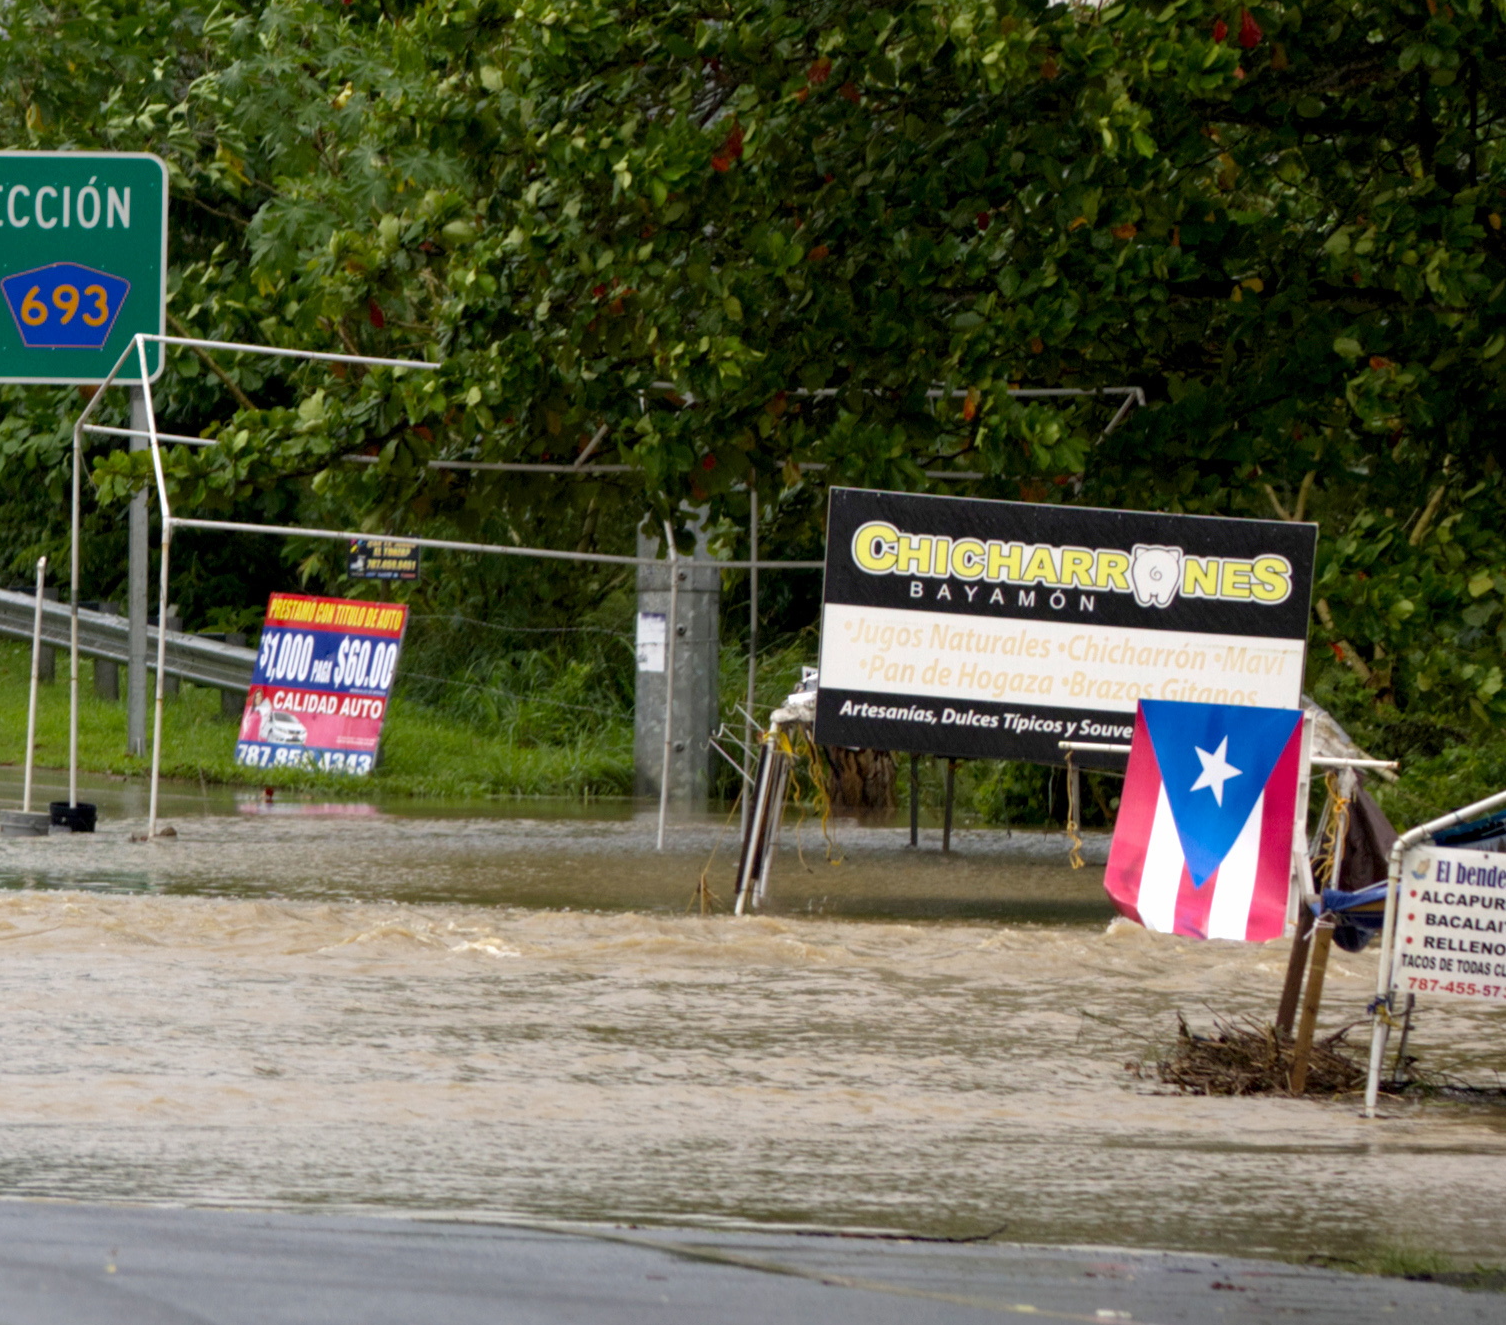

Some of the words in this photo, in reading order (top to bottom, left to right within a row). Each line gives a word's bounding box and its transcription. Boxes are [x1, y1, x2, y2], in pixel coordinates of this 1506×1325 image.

[20, 284, 109, 326] 693
[910, 581, 1095, 612] BAYAMÓN
[268, 598, 317, 623] PRESTAMO
[315, 601, 337, 624] CON
[334, 604, 367, 628] TITULO
[364, 607, 380, 629] DE
[376, 608, 403, 631] AUTO
[850, 618, 924, 652] Jugos
[929, 623, 1052, 659] Naturales
[1068, 635, 1207, 670] Chicharrón
[333, 635, 398, 690] $60.00
[867, 654, 915, 684] Pan
[921, 658, 953, 687] de
[957, 662, 1054, 698] Hogaza
[1068, 671, 1154, 702] Brazos
[1160, 678, 1259, 707] Gitanos
[273, 690, 338, 715] CALIDAD
[339, 697, 383, 720] AUTO
[839, 700, 938, 725] Artesanías,
[941, 708, 999, 727] Dulces
[1003, 712, 1063, 734] Típicos
[1064, 720, 1078, 737] y
[1079, 719, 1133, 738] Souve
[1435, 860, 1451, 883] El
[1425, 912, 1506, 933] BACALAI
[1402, 953, 1437, 970] TACOS
[1439, 958, 1454, 972] DE
[1457, 960, 1492, 976] TODAS
